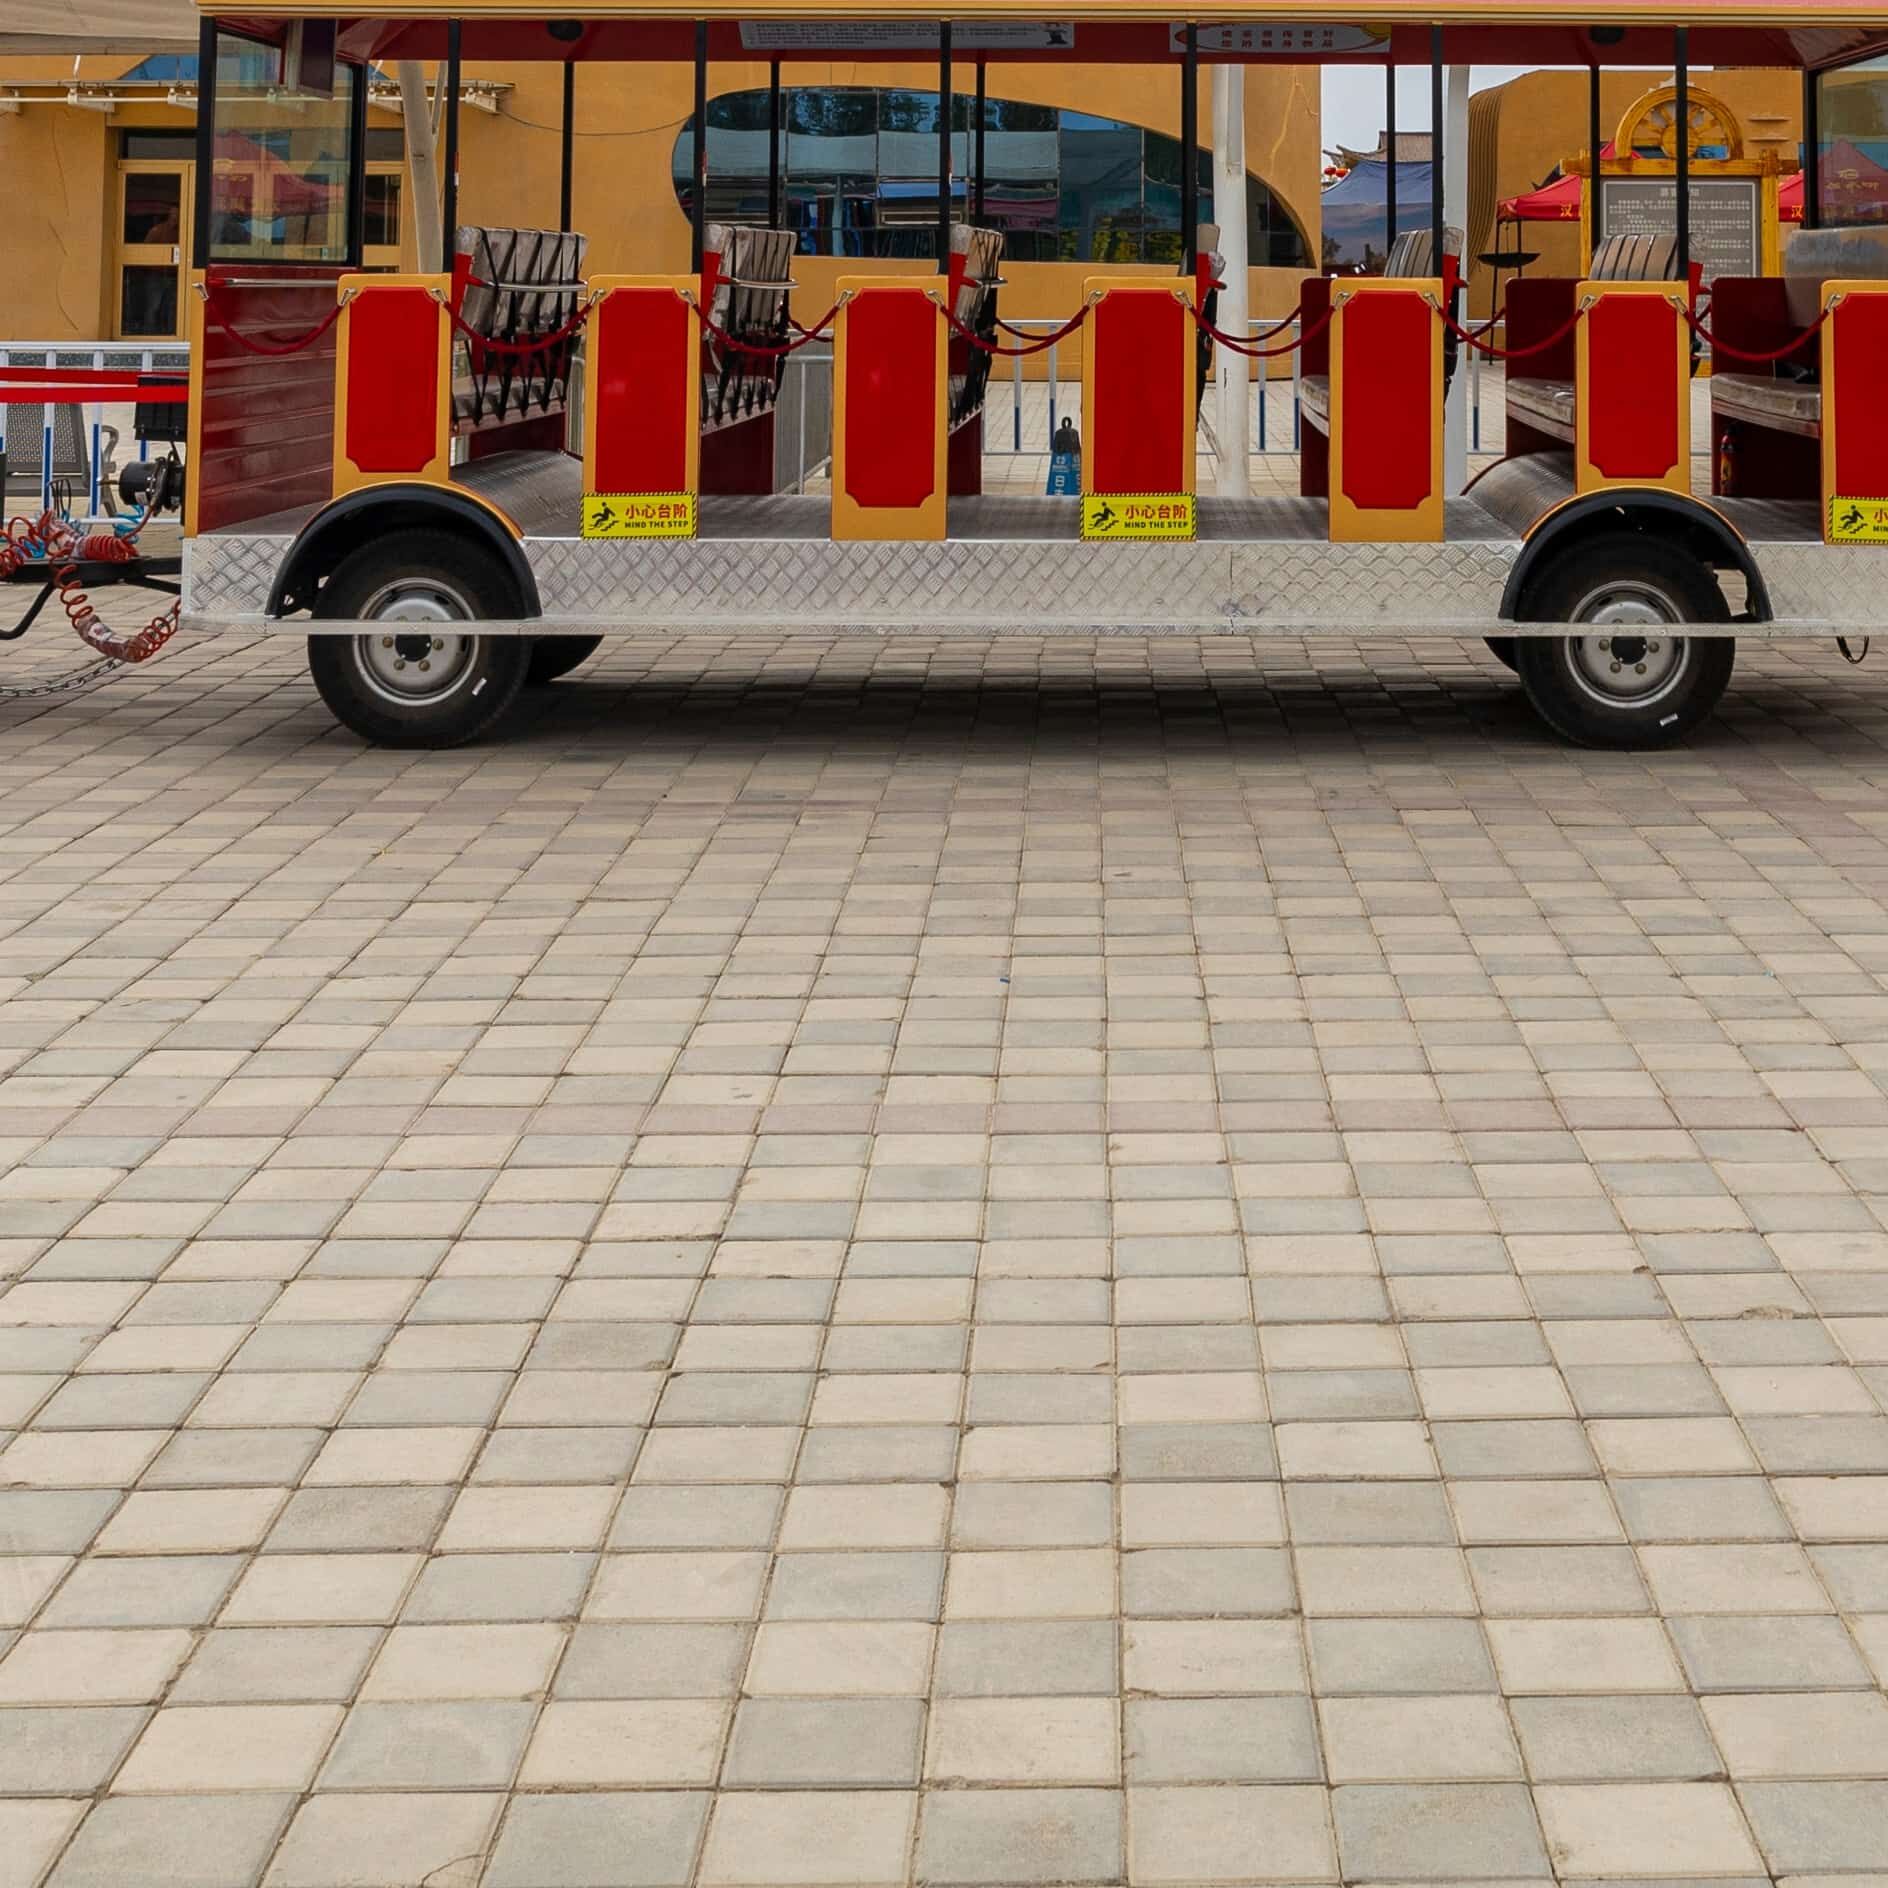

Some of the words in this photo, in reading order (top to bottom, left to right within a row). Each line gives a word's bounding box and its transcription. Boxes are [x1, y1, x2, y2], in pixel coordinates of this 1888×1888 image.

[625, 503, 689, 520] 小心台阶
[1125, 504, 1188, 520] 小心台阶
[624, 521, 646, 529] MIND
[649, 521, 665, 529] THE
[667, 520, 689, 528] STEP
[1124, 521, 1146, 529] MIND
[1149, 521, 1165, 529] THE
[1167, 521, 1188, 529] STEP
